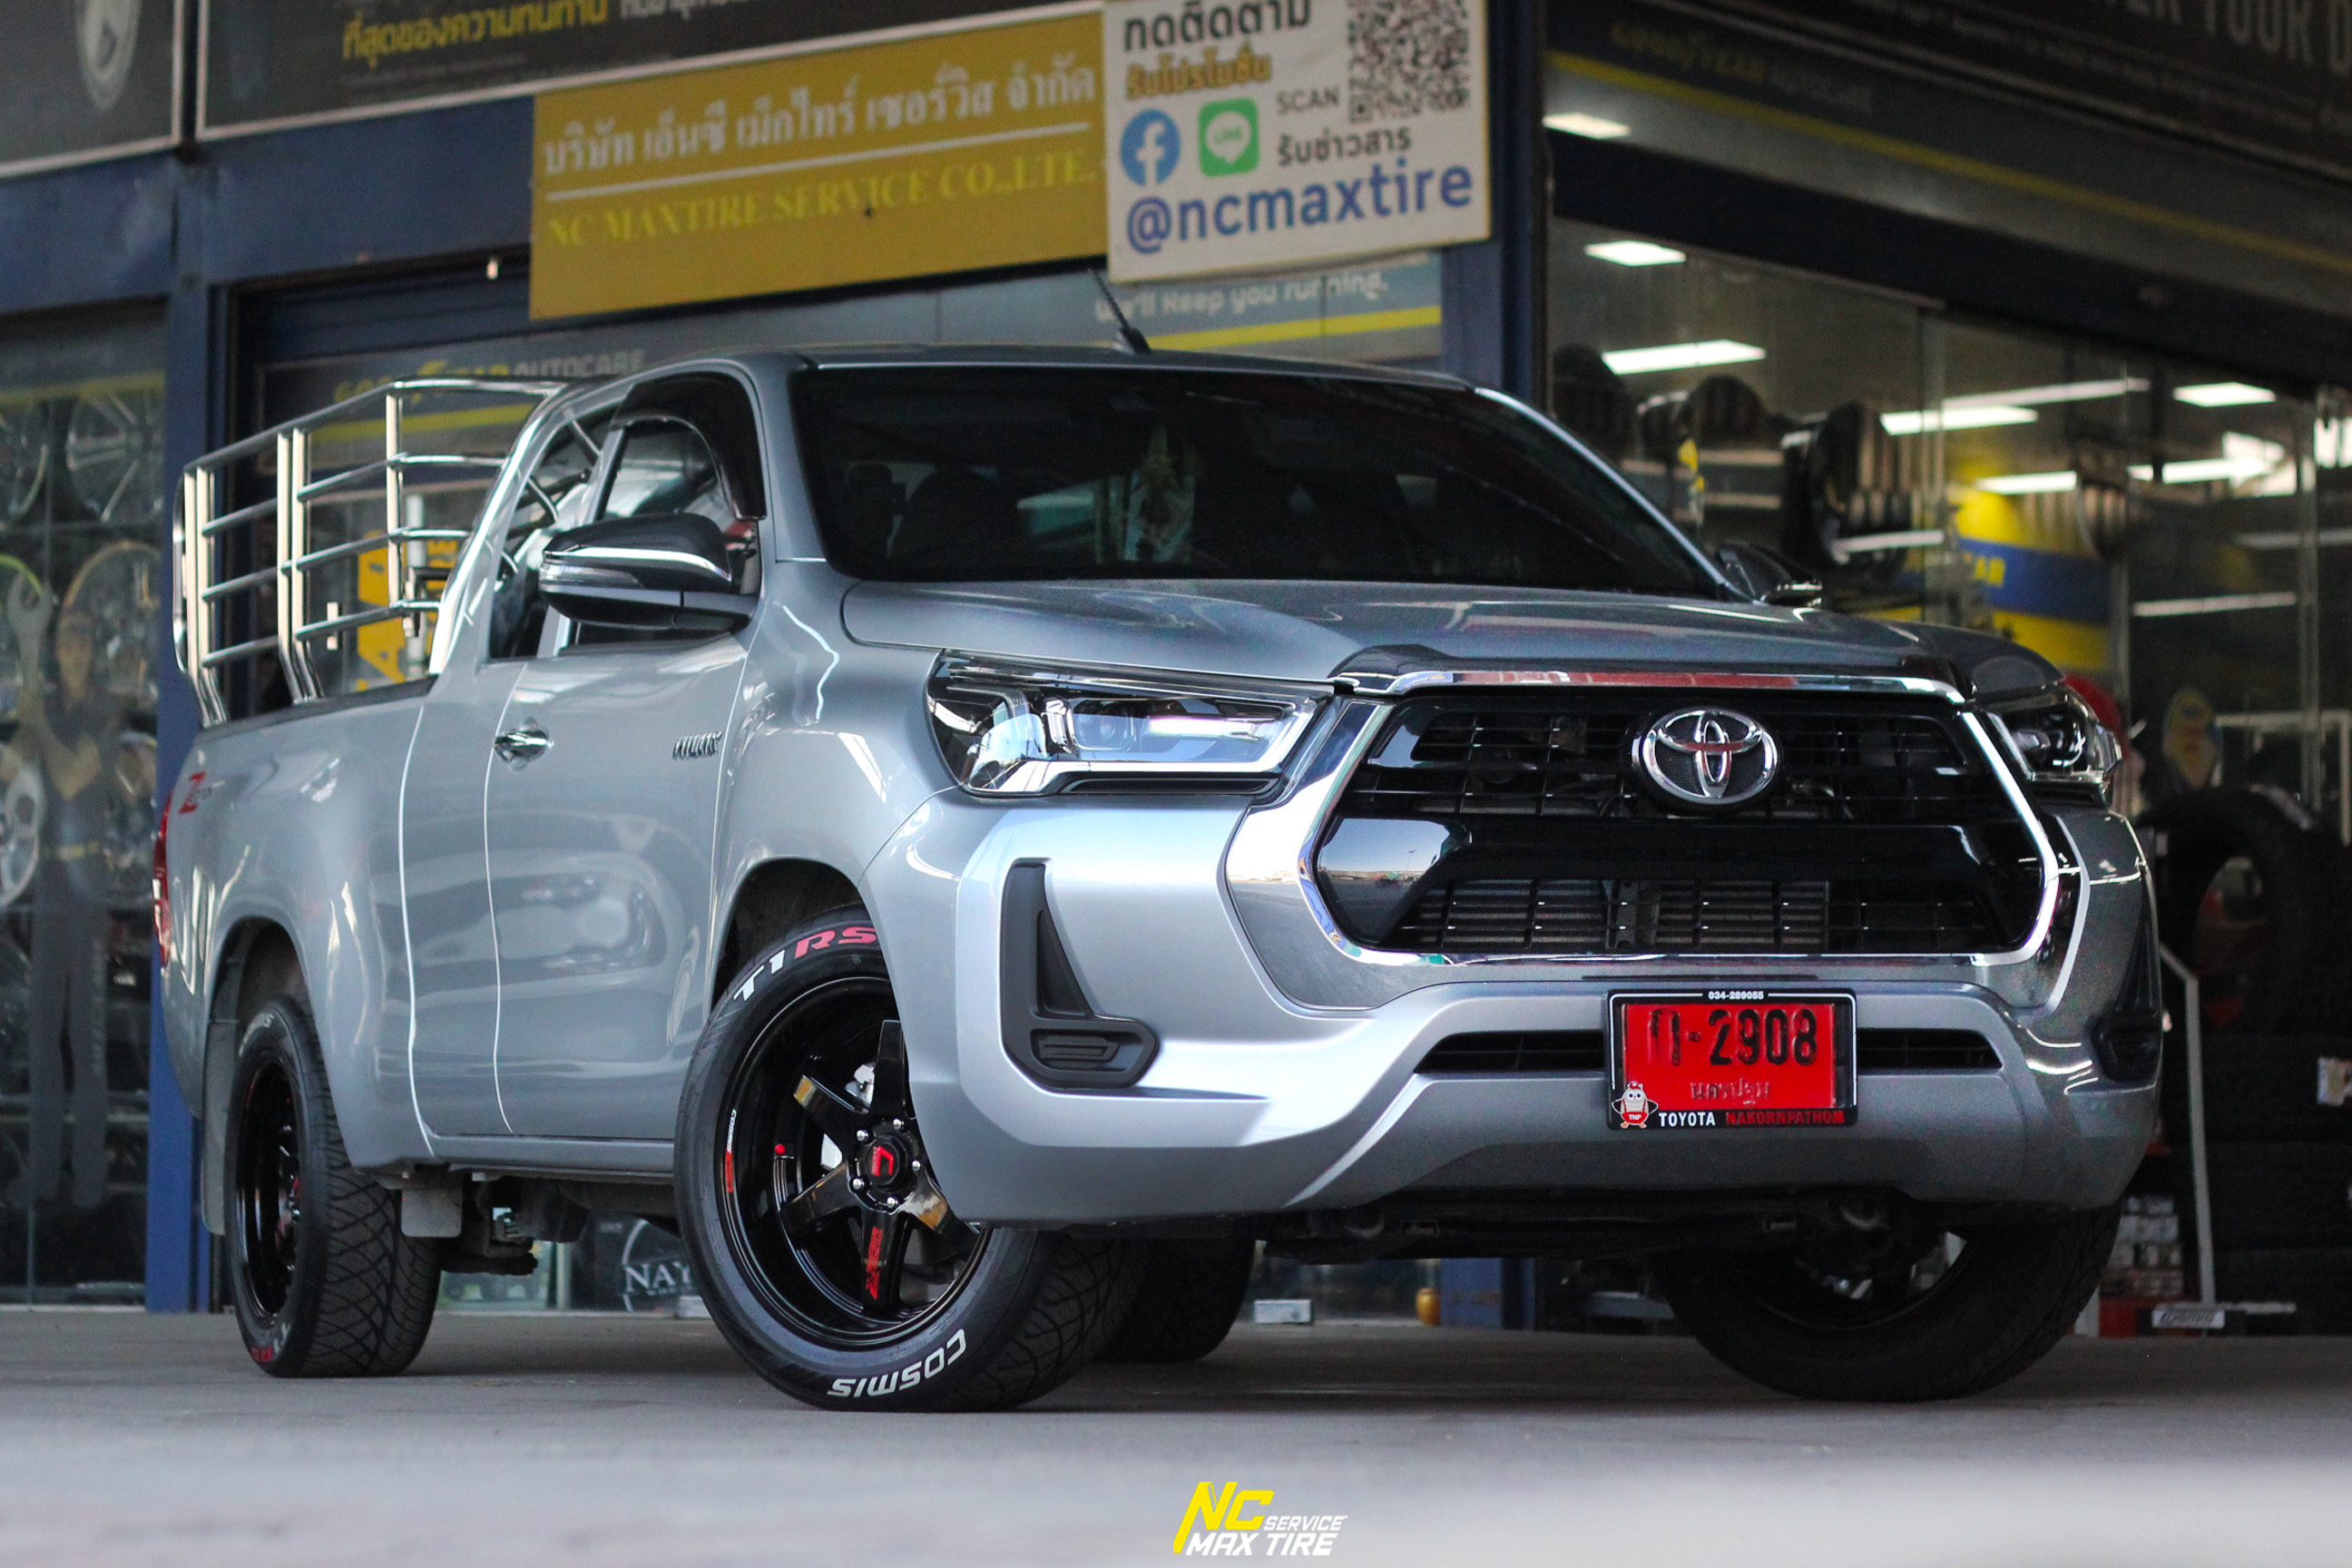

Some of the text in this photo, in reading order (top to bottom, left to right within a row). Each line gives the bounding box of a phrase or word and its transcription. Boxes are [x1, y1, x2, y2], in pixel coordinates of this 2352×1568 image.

[1124, 0, 1310, 51] กดติดตาม
[544, 118, 635, 175] บริษัท
[1005, 51, 1096, 113] จำกัด
[1276, 86, 1339, 115] SCAN
[1278, 126, 1413, 167] รับข่าวสาร
[548, 213, 593, 247] NC
[604, 192, 760, 240] MAXTIRE
[771, 170, 932, 221] SERVICE
[1126, 156, 1474, 255] @ncmaxtire
[1707, 990, 1765, 1001] 034-289055
[1658, 1110, 1846, 1128] TOYOTA NAKORNPATHOM
[826, 1328, 967, 1398] COSMIS
